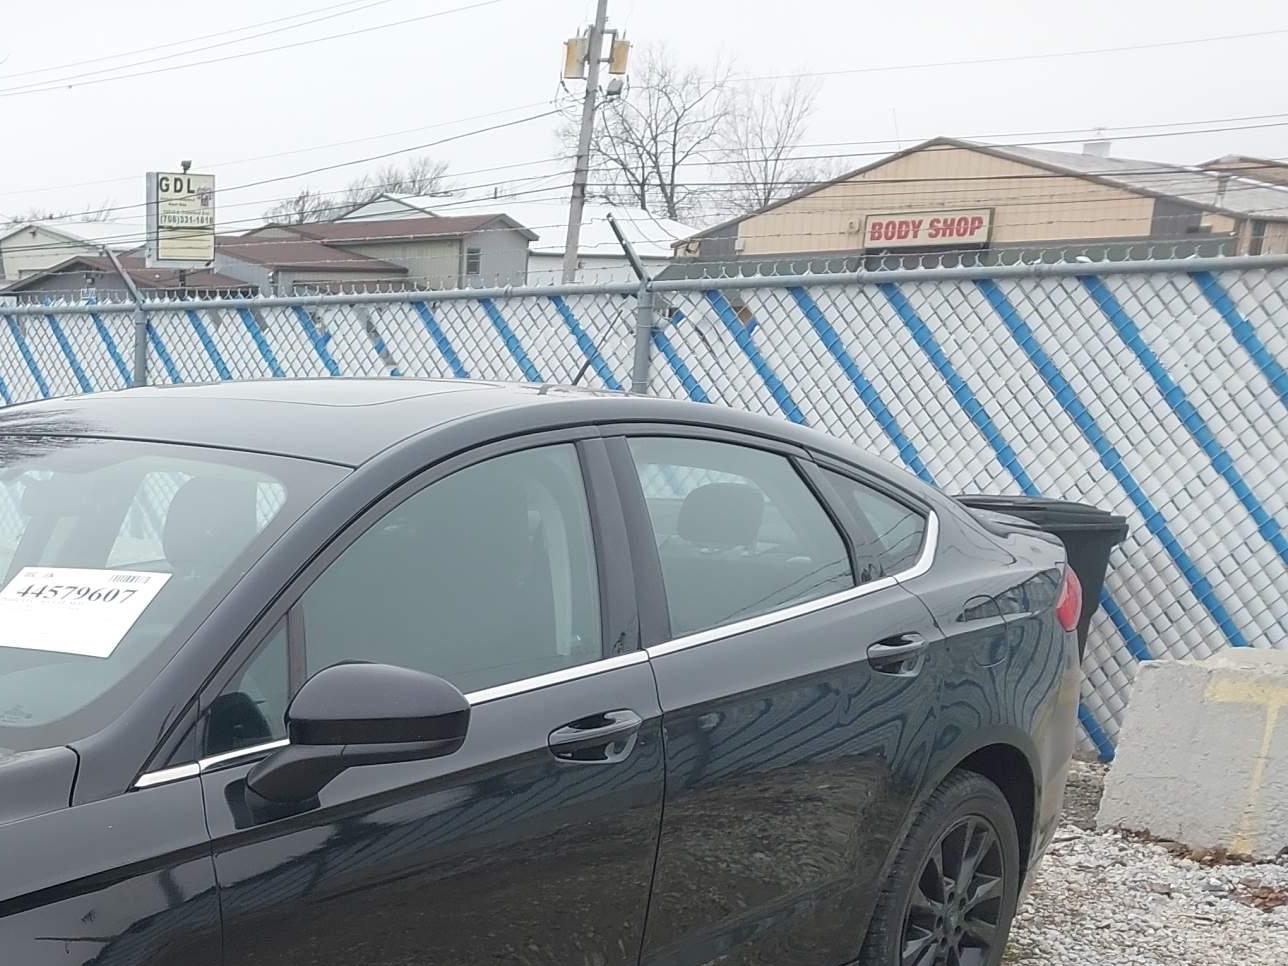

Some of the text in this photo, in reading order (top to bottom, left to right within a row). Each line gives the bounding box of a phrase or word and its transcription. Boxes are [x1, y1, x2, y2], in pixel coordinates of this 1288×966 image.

[160, 177, 195, 193] GDL
[870, 216, 983, 241] BODY SHOP
[16, 584, 138, 604] 44579607
